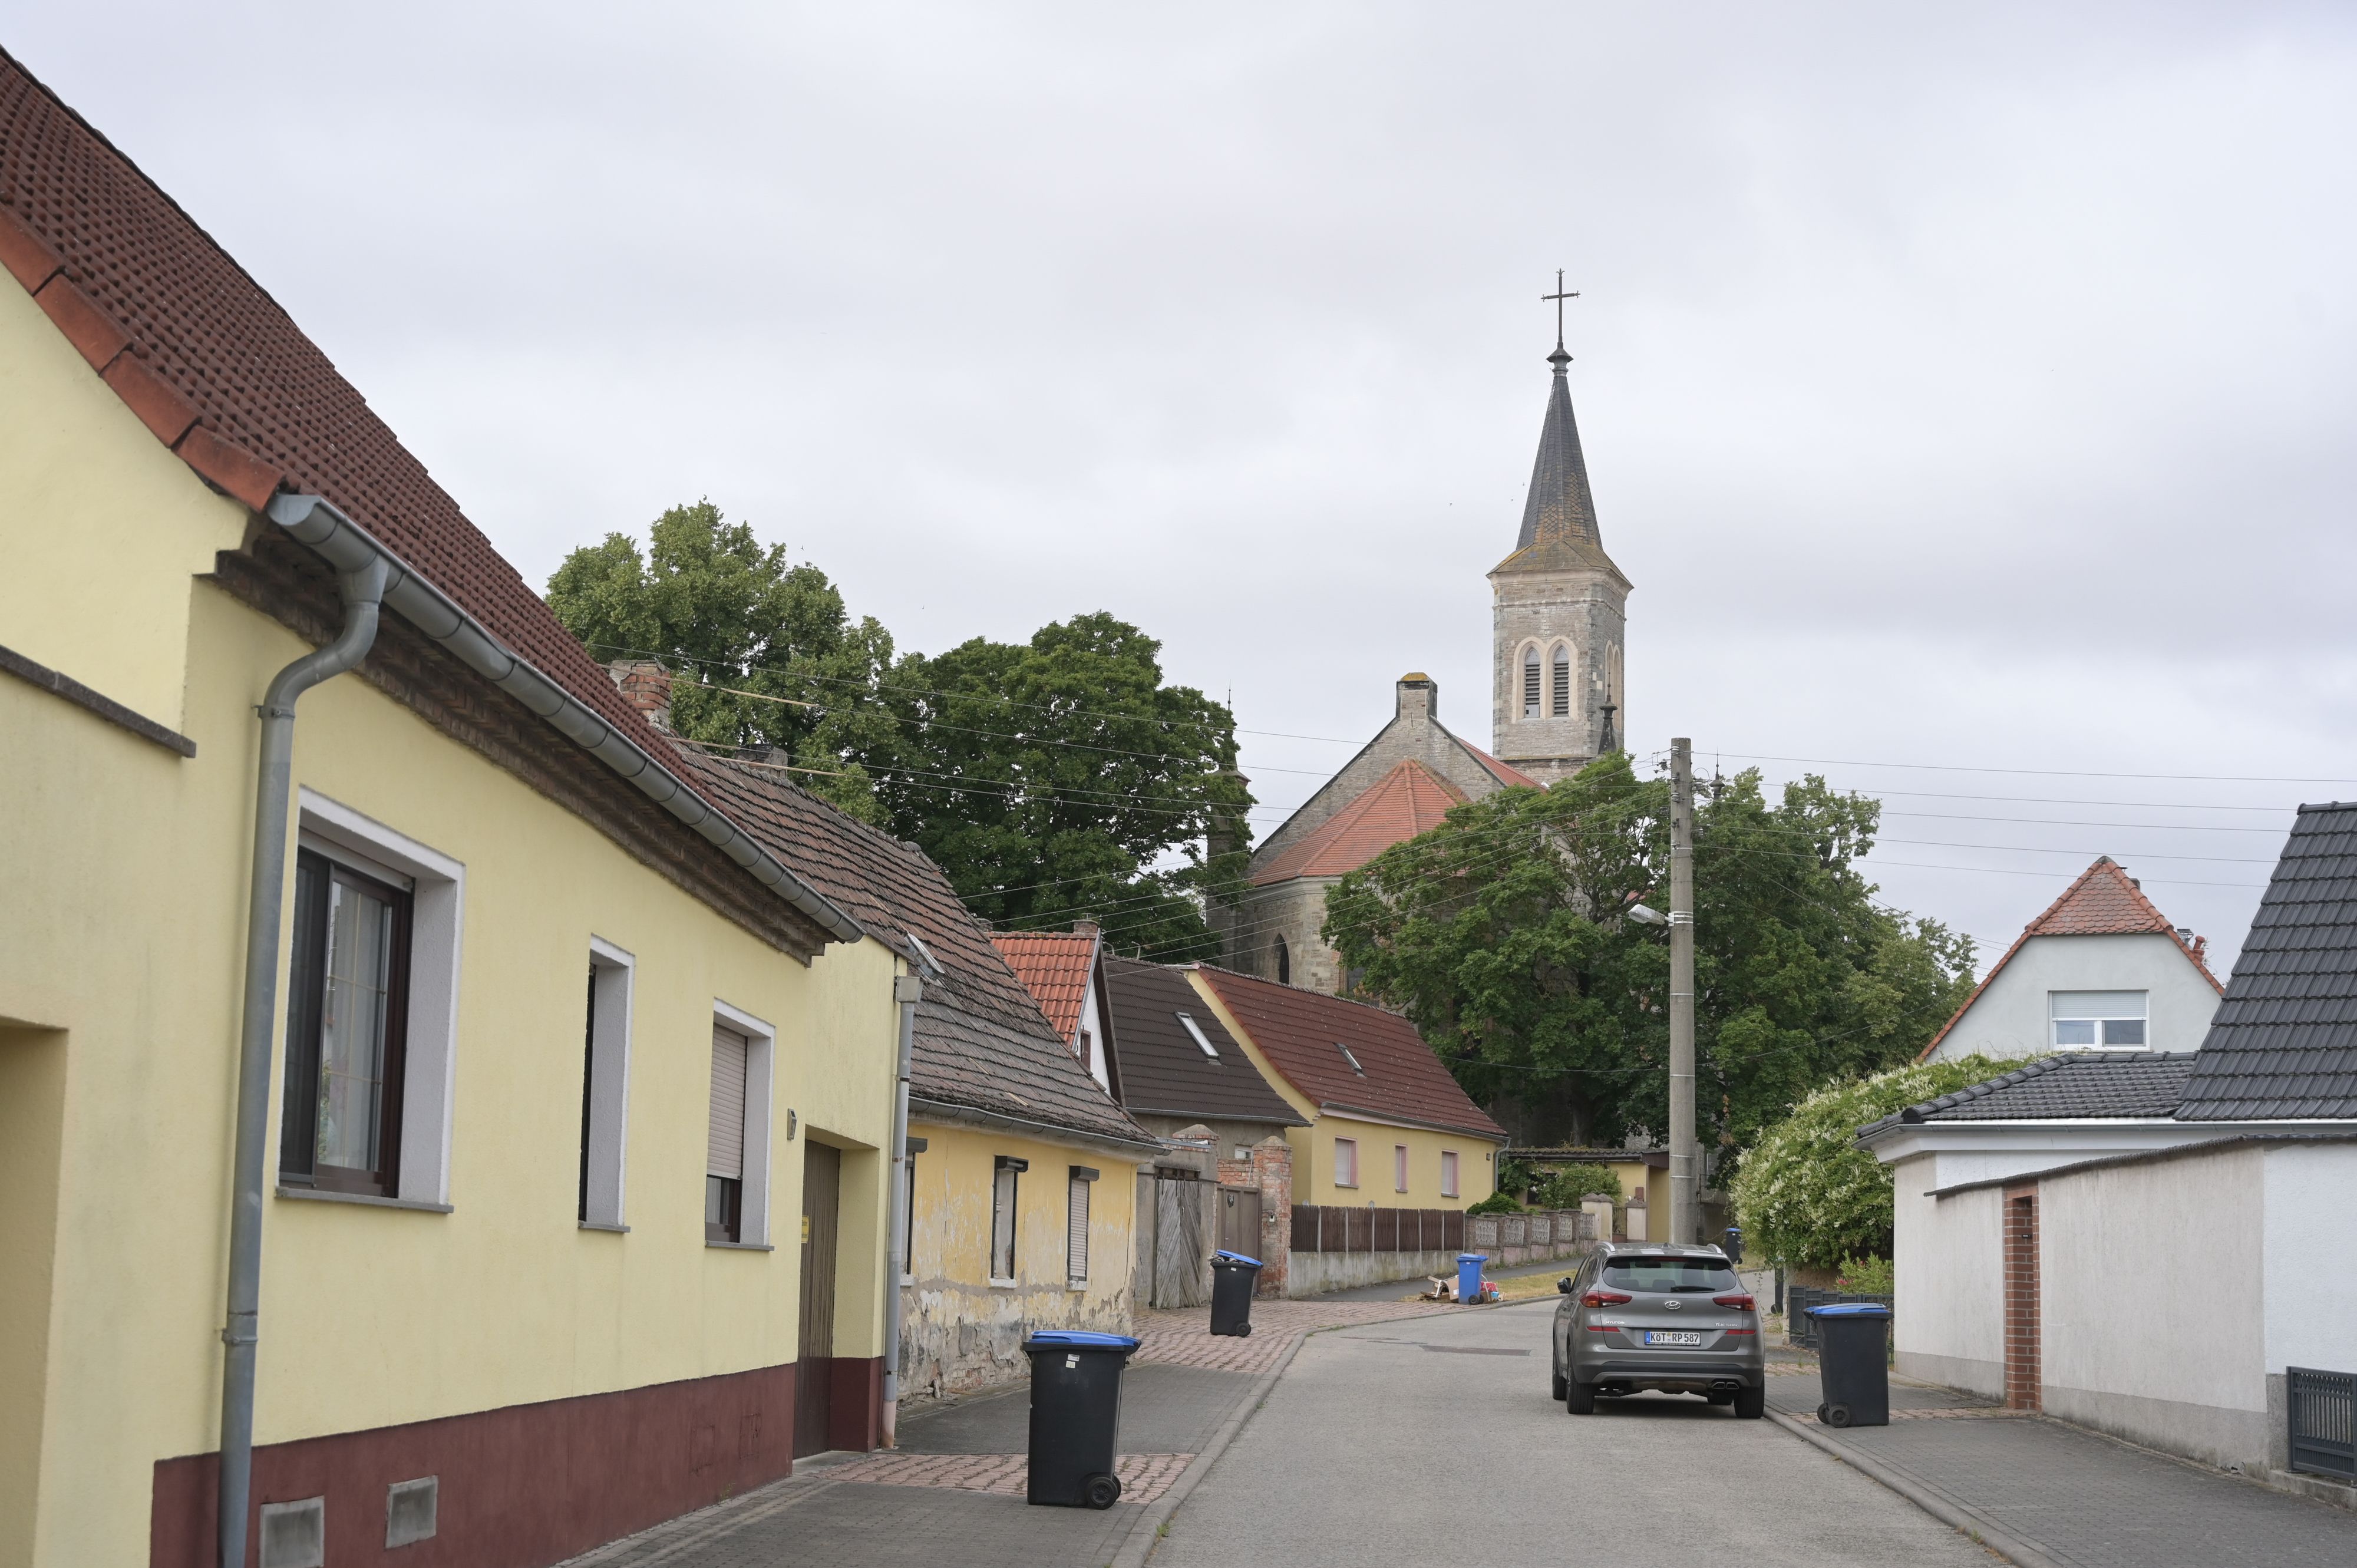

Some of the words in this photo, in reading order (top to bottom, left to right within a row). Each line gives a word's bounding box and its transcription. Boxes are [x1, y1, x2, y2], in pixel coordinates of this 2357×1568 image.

[1650, 1333, 1666, 1342] KÖT
[1672, 1333, 1682, 1342] RP
[1684, 1333, 1699, 1343] 587
